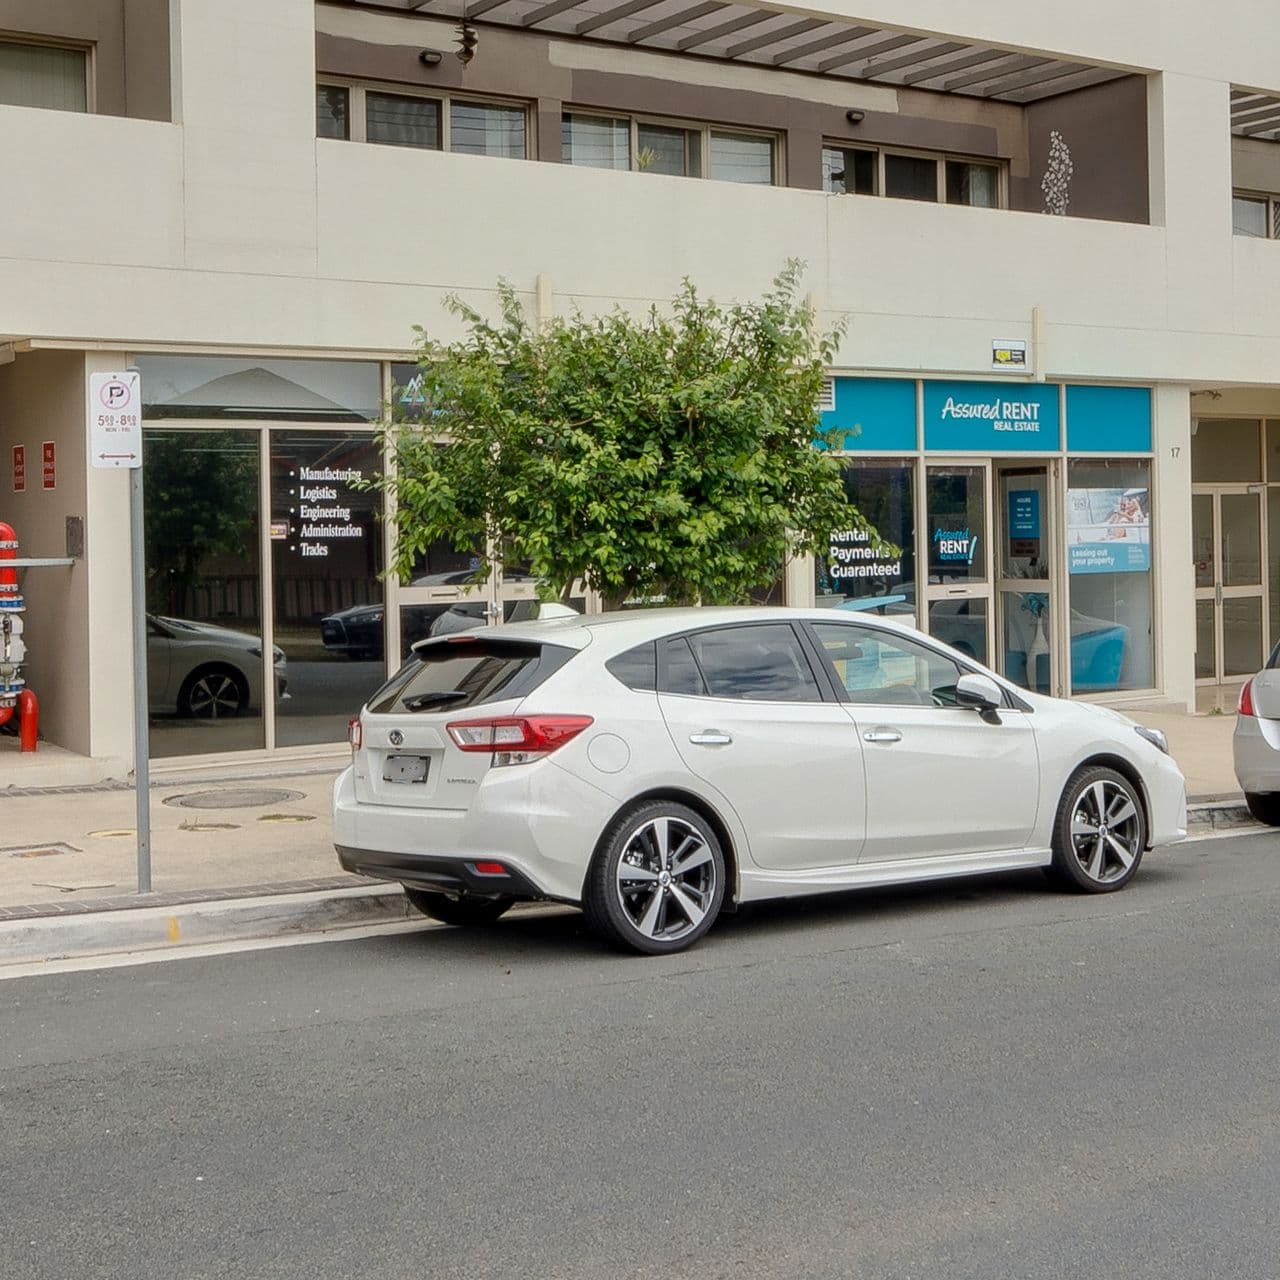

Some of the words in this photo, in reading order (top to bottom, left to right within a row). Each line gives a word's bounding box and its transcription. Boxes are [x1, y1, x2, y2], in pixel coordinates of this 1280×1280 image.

[941, 397, 1000, 420] Assured
[1002, 402, 1040, 420] RENT
[993, 421, 1013, 431] REAL
[1014, 421, 1040, 432] ESTATE
[1171, 447, 1180, 458] 17
[300, 486, 337, 502] Logistics
[300, 505, 351, 521] Engineering
[300, 524, 362, 537] Administration
[300, 542, 328, 556] Trades
[830, 561, 901, 578] Guaranteed
